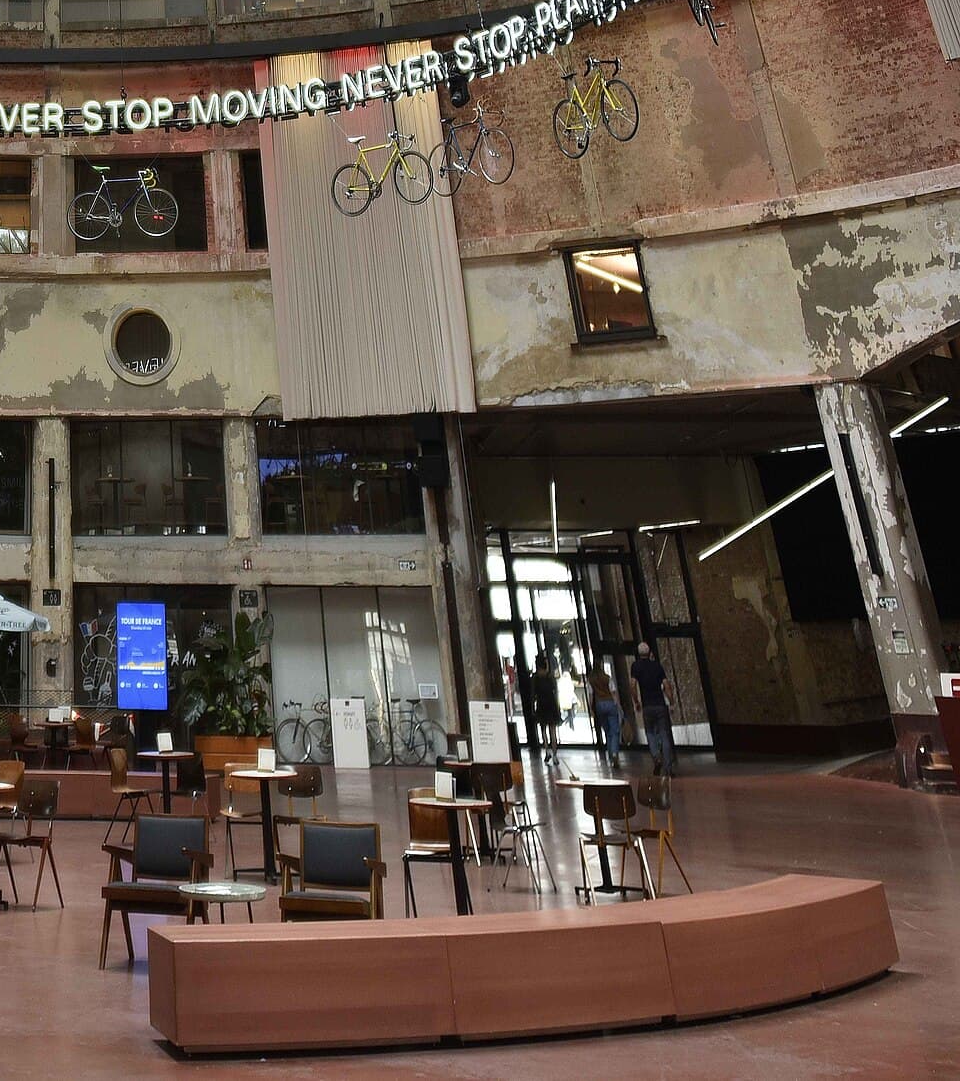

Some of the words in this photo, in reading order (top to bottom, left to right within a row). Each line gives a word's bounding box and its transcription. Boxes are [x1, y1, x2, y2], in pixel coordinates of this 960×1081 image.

[82, 98, 173, 133] STOP
[191, 78, 327, 125] MOVING
[341, 50, 443, 102] NEVER
[454, 15, 525, 70] STOP
[121, 618, 135, 626] TOUR
[142, 618, 162, 626] FRANCE
